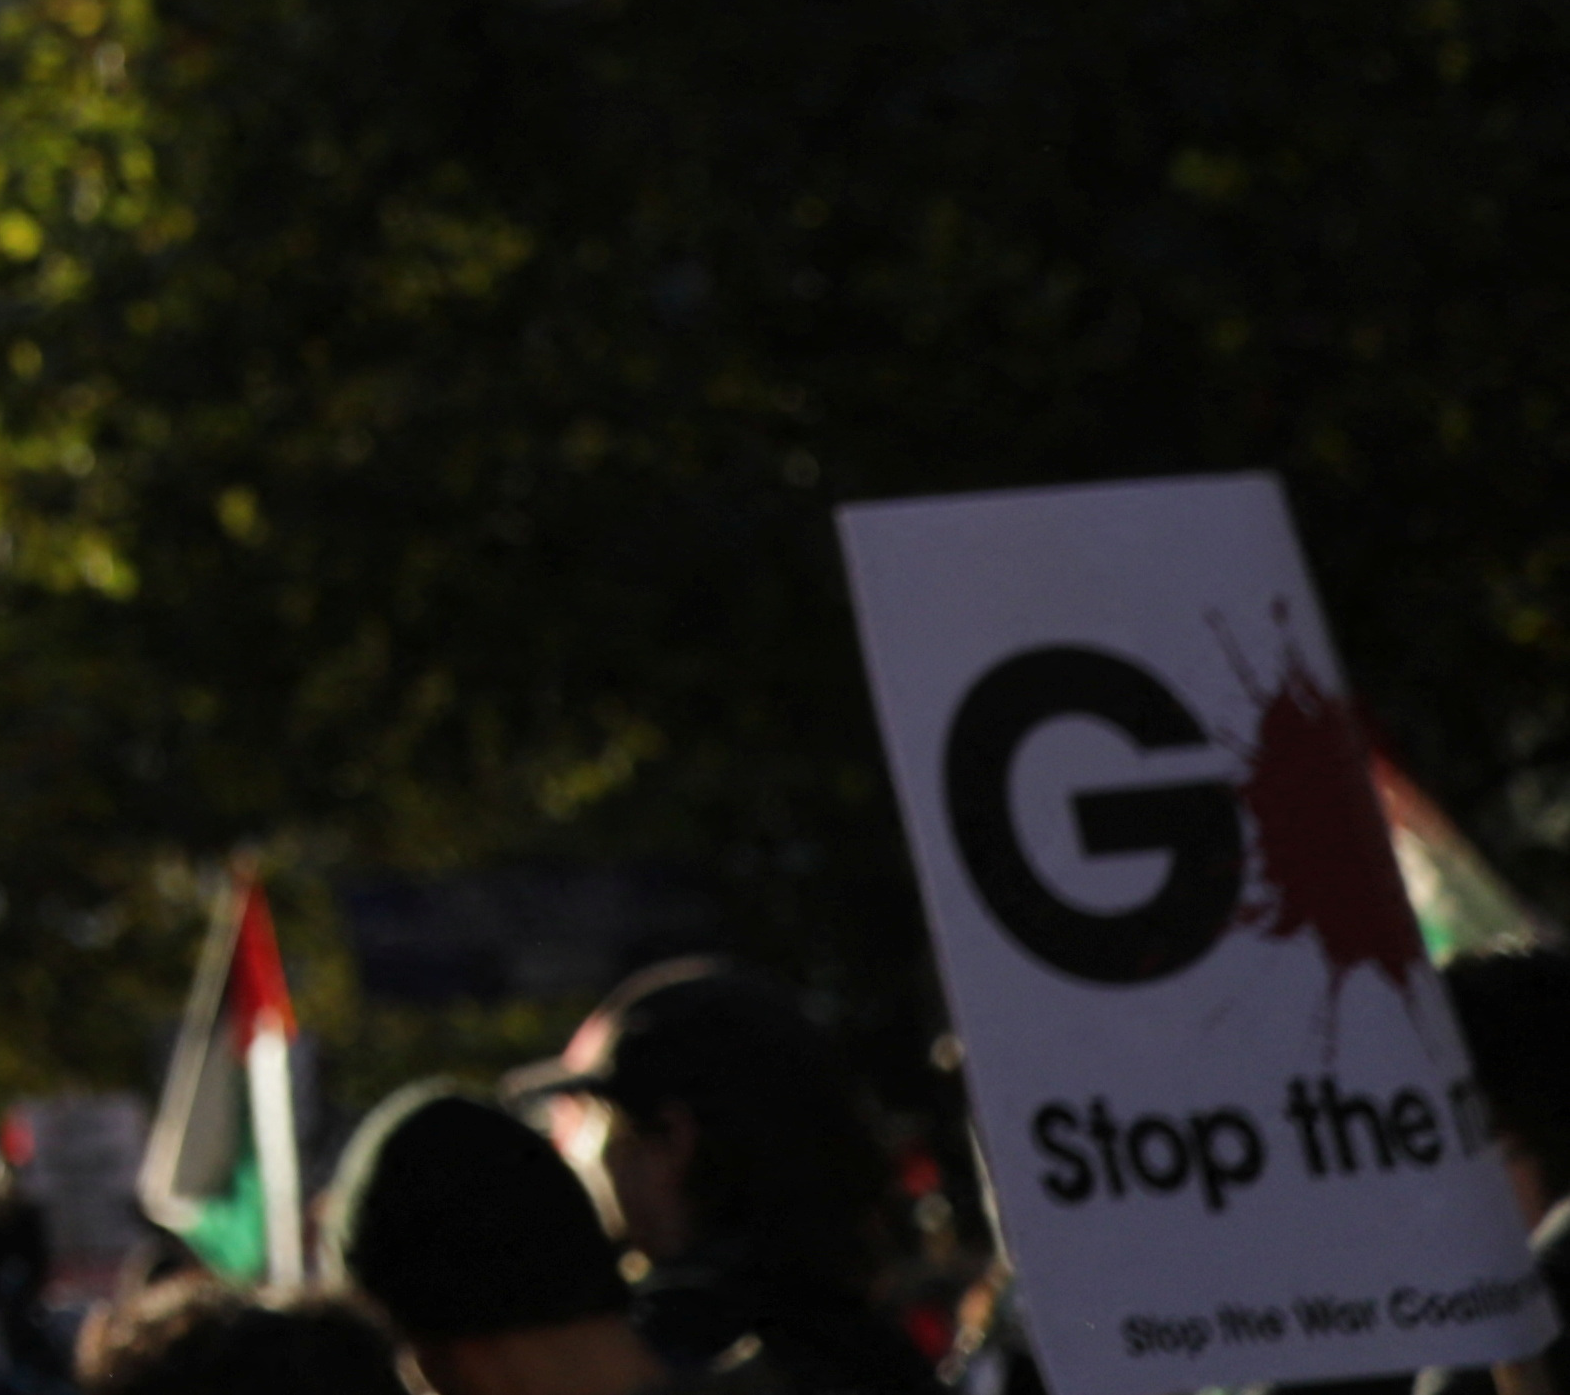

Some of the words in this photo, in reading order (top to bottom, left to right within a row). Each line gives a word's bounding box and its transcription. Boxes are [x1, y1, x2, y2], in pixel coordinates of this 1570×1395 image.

[1032, 1095, 1266, 1213] Stop
[1285, 1073, 1442, 1178] the
[1121, 1314, 1213, 1359] Stop
[1214, 1302, 1287, 1344] the
[1293, 1294, 1379, 1340] War
